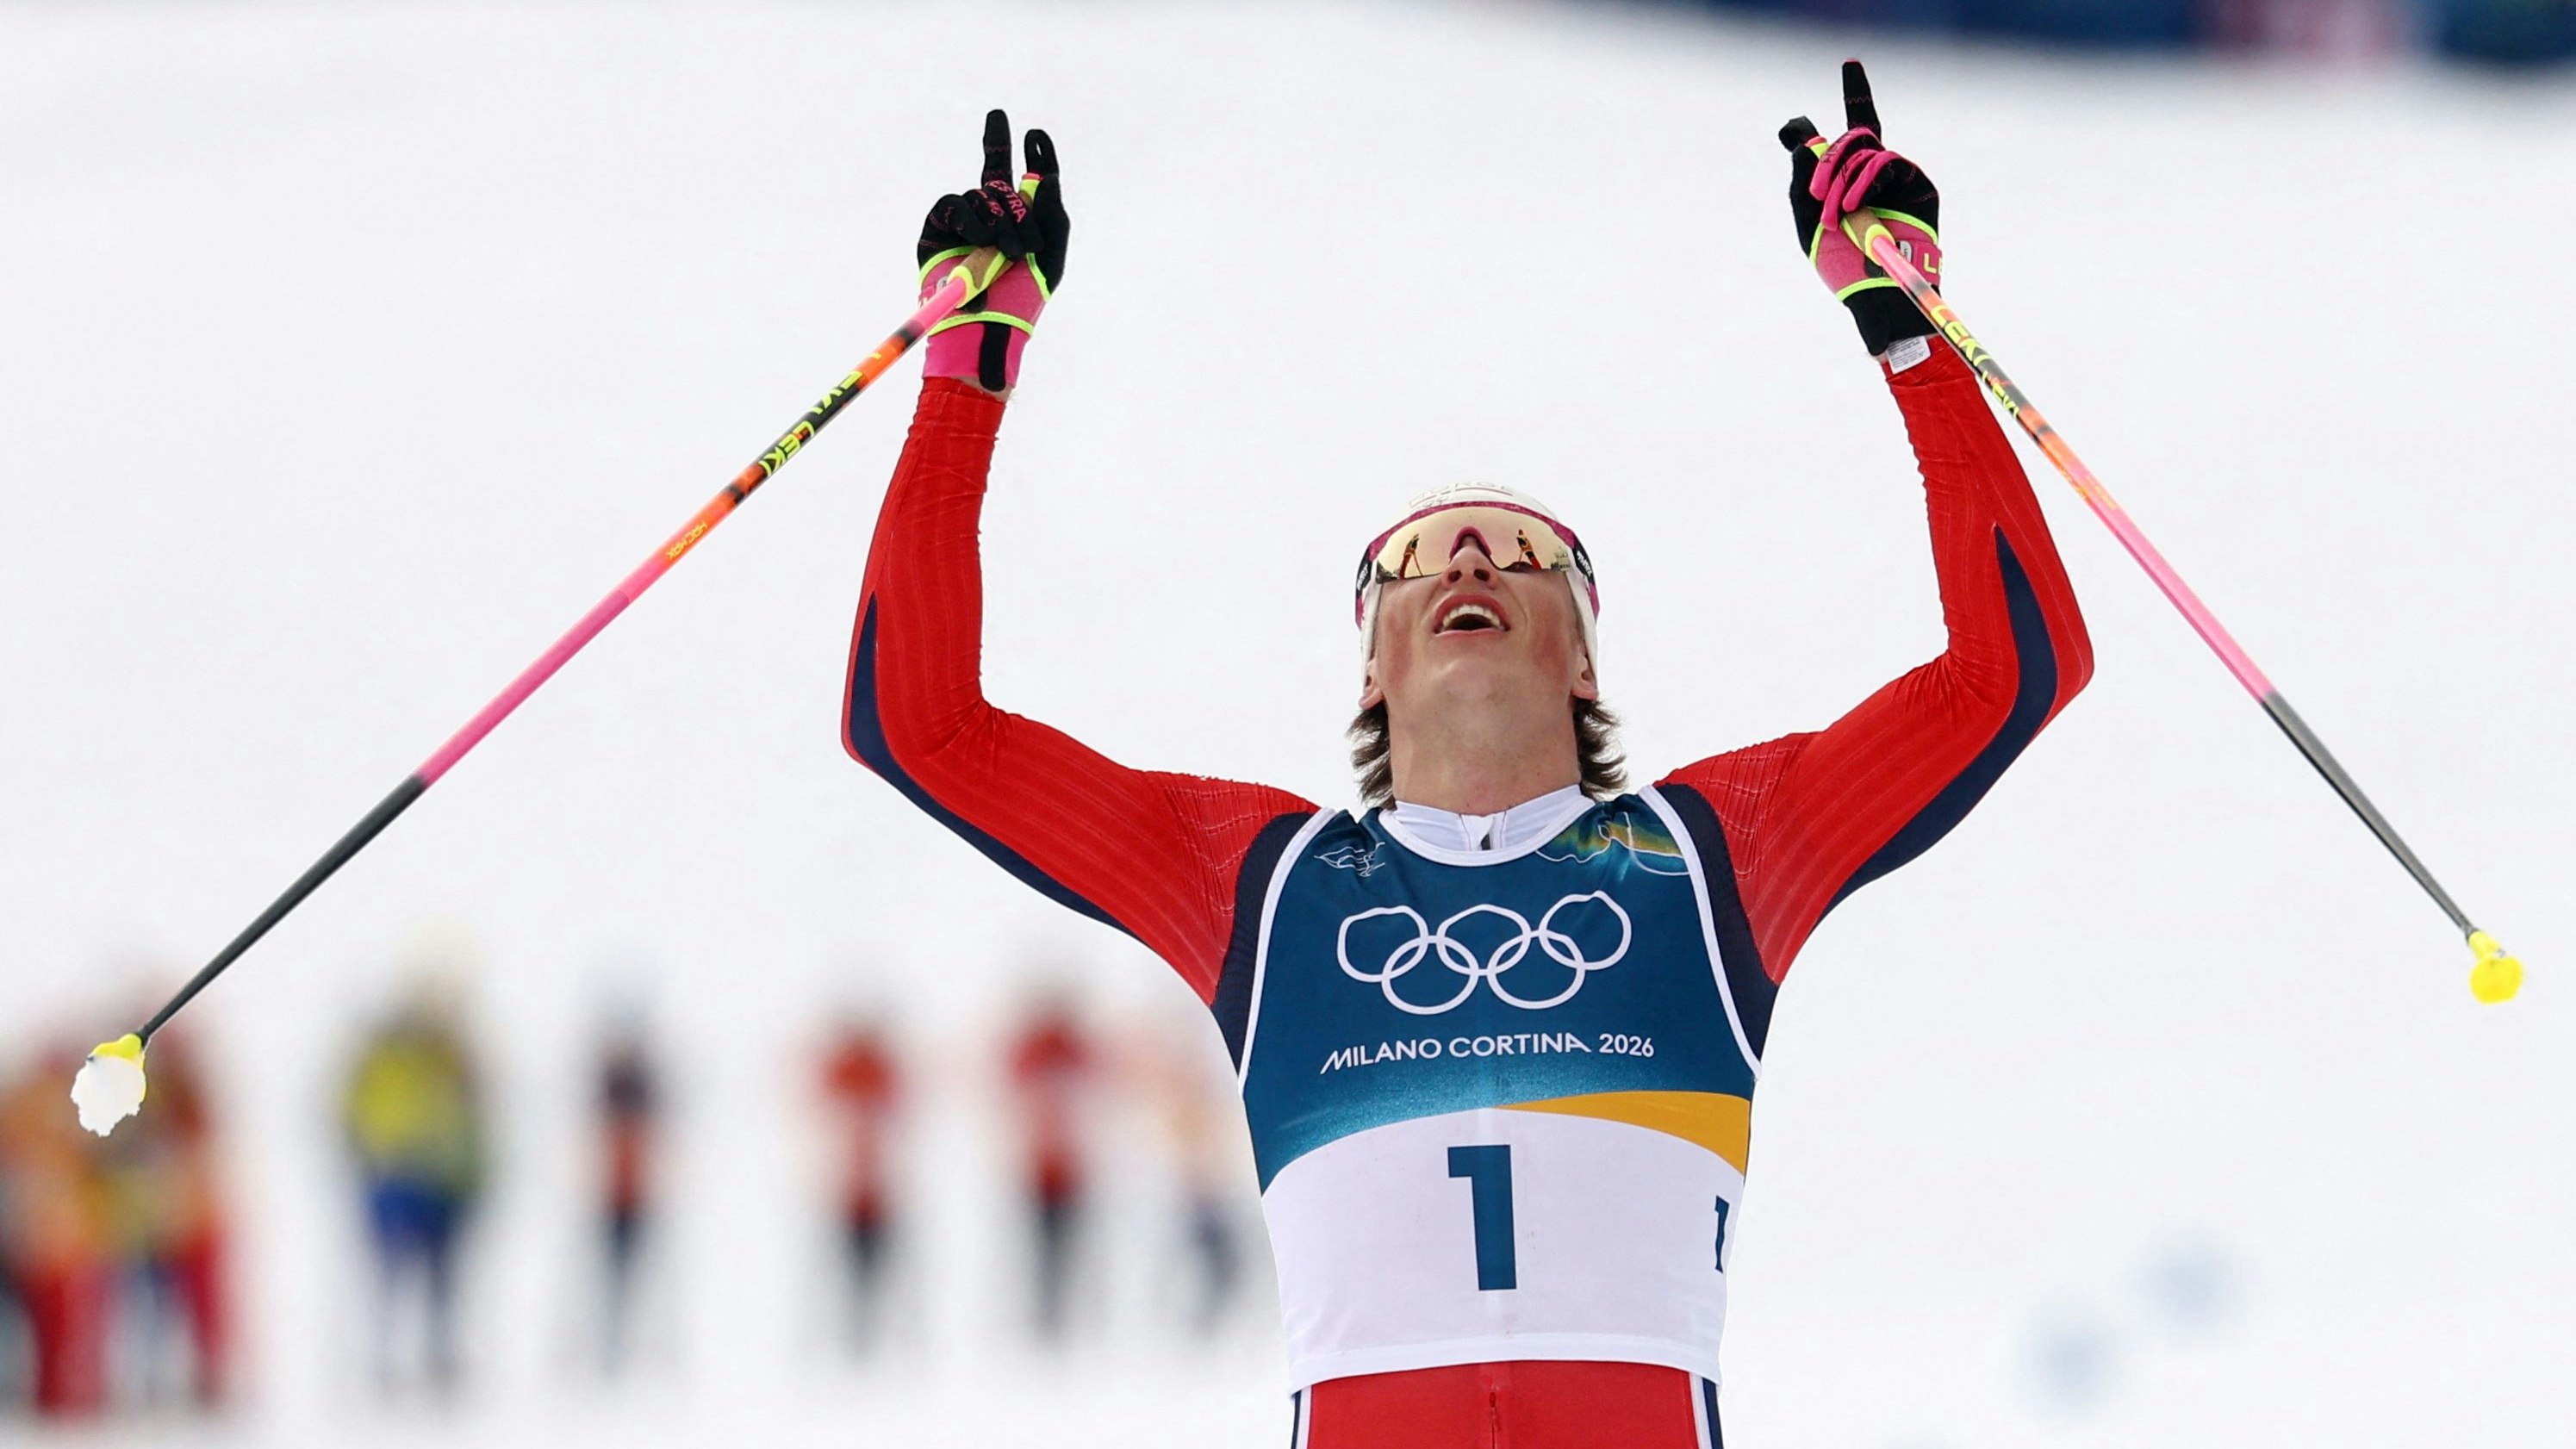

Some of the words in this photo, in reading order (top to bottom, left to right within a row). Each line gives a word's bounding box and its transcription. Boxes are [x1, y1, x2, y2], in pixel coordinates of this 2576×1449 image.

[1930, 306, 1993, 368] LEKI
[758, 420, 815, 477] LEKI
[1320, 1038, 1442, 1074] MILANO
[1448, 1032, 1591, 1058] CORTINA
[1599, 1033, 1654, 1057] 2026
[1447, 1145, 1517, 1290] 1
[1714, 1195, 1730, 1274] 1
